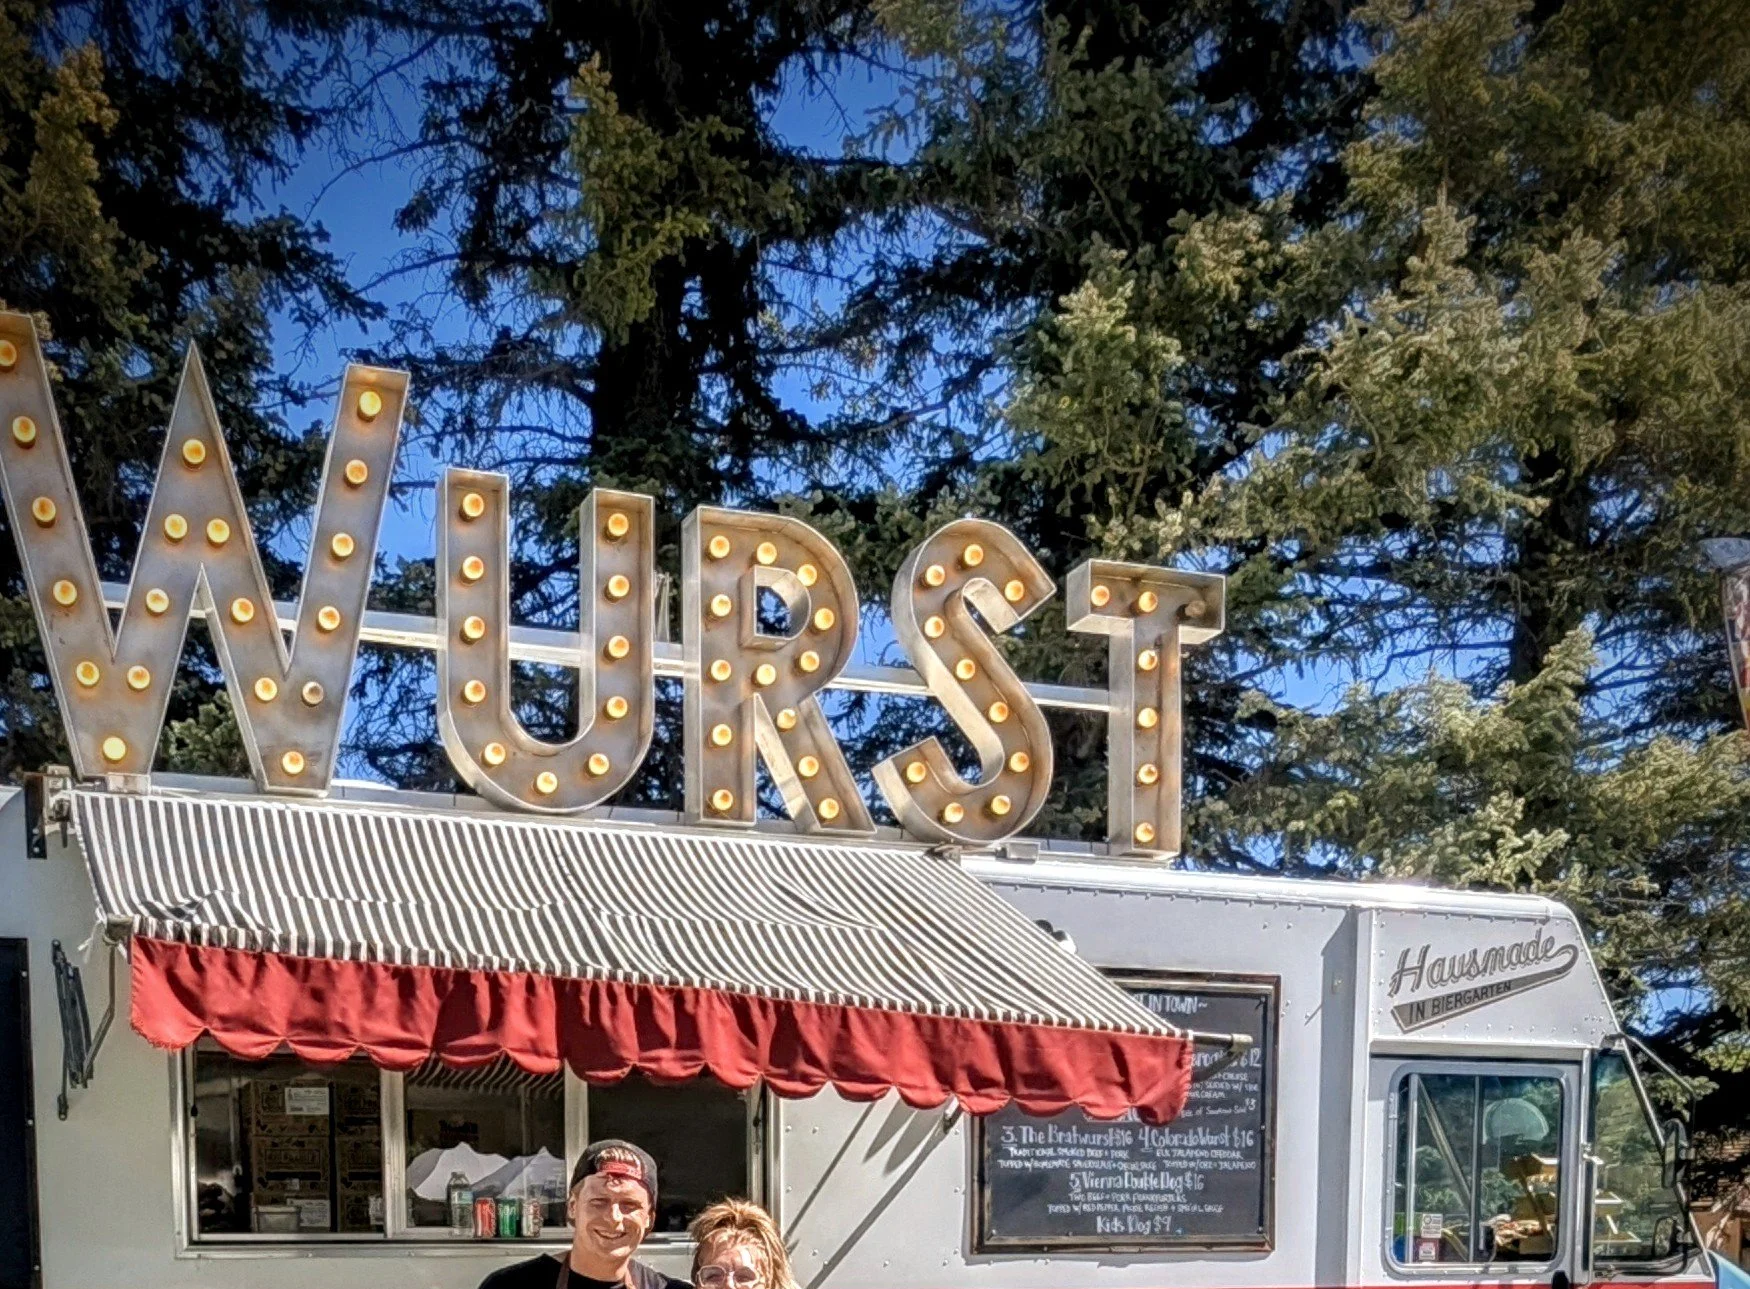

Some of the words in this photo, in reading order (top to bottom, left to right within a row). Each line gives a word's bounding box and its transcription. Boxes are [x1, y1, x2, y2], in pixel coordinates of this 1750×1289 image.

[0, 313, 1226, 861] WURST
[1388, 927, 1556, 997] Hausmade
[1149, 994, 1161, 1013] IN
[1165, 995, 1198, 1015] TOWN
[1410, 1003, 1425, 1025] IN
[1431, 980, 1512, 1017] BIERGARTEN
[1019, 1125, 1045, 1144] The
[1048, 1124, 1116, 1146] Bratwurst
[1232, 1127, 1254, 1148] $16
[1082, 1171, 1123, 1189] Vienna
[1124, 1171, 1158, 1190] Double
[1160, 1171, 1183, 1193] Dog
[1184, 1171, 1205, 1191] $16
[1097, 1215, 1125, 1234] Kids
[1127, 1215, 1151, 1235] Dog
[1153, 1215, 1172, 1234] $9
